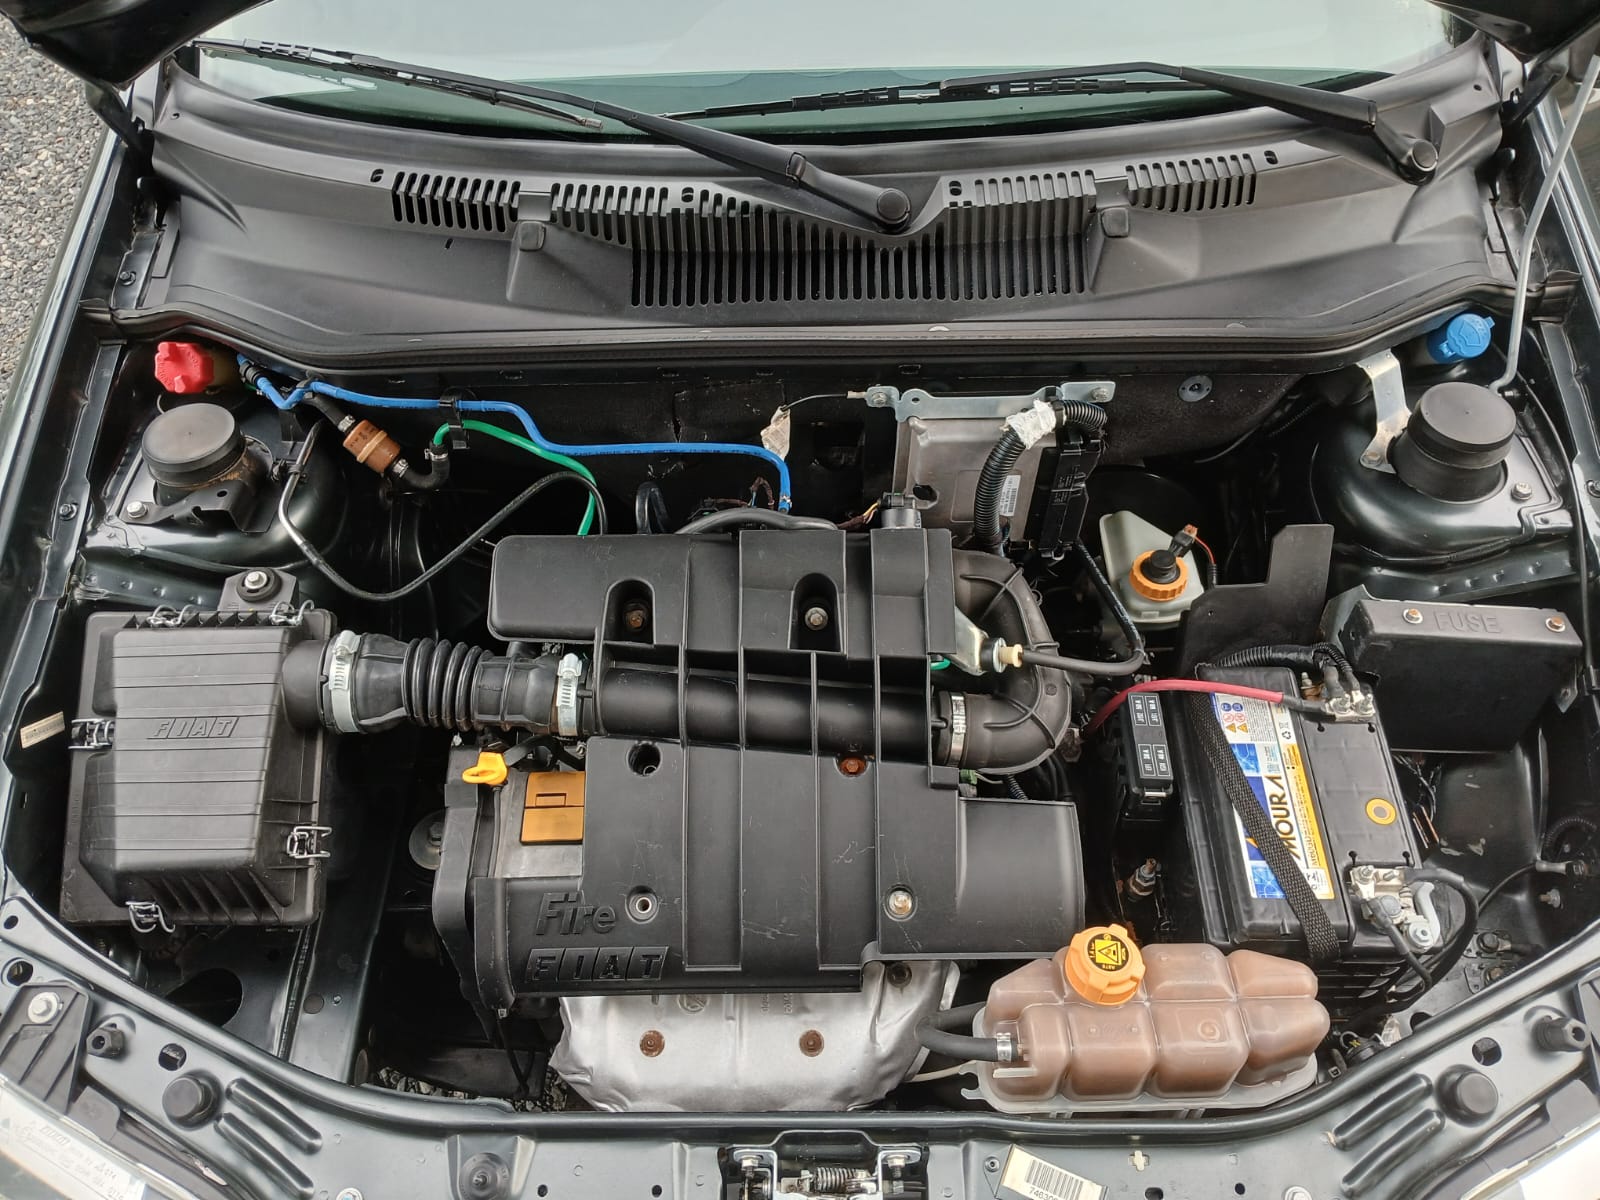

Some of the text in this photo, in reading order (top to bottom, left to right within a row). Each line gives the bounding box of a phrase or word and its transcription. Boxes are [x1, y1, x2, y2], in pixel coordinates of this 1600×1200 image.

[1433, 609, 1502, 634] FUSE
[152, 719, 235, 738] FIAT
[1264, 775, 1302, 860] MOURA
[536, 891, 617, 936] Fire
[529, 951, 664, 981] FIAT
